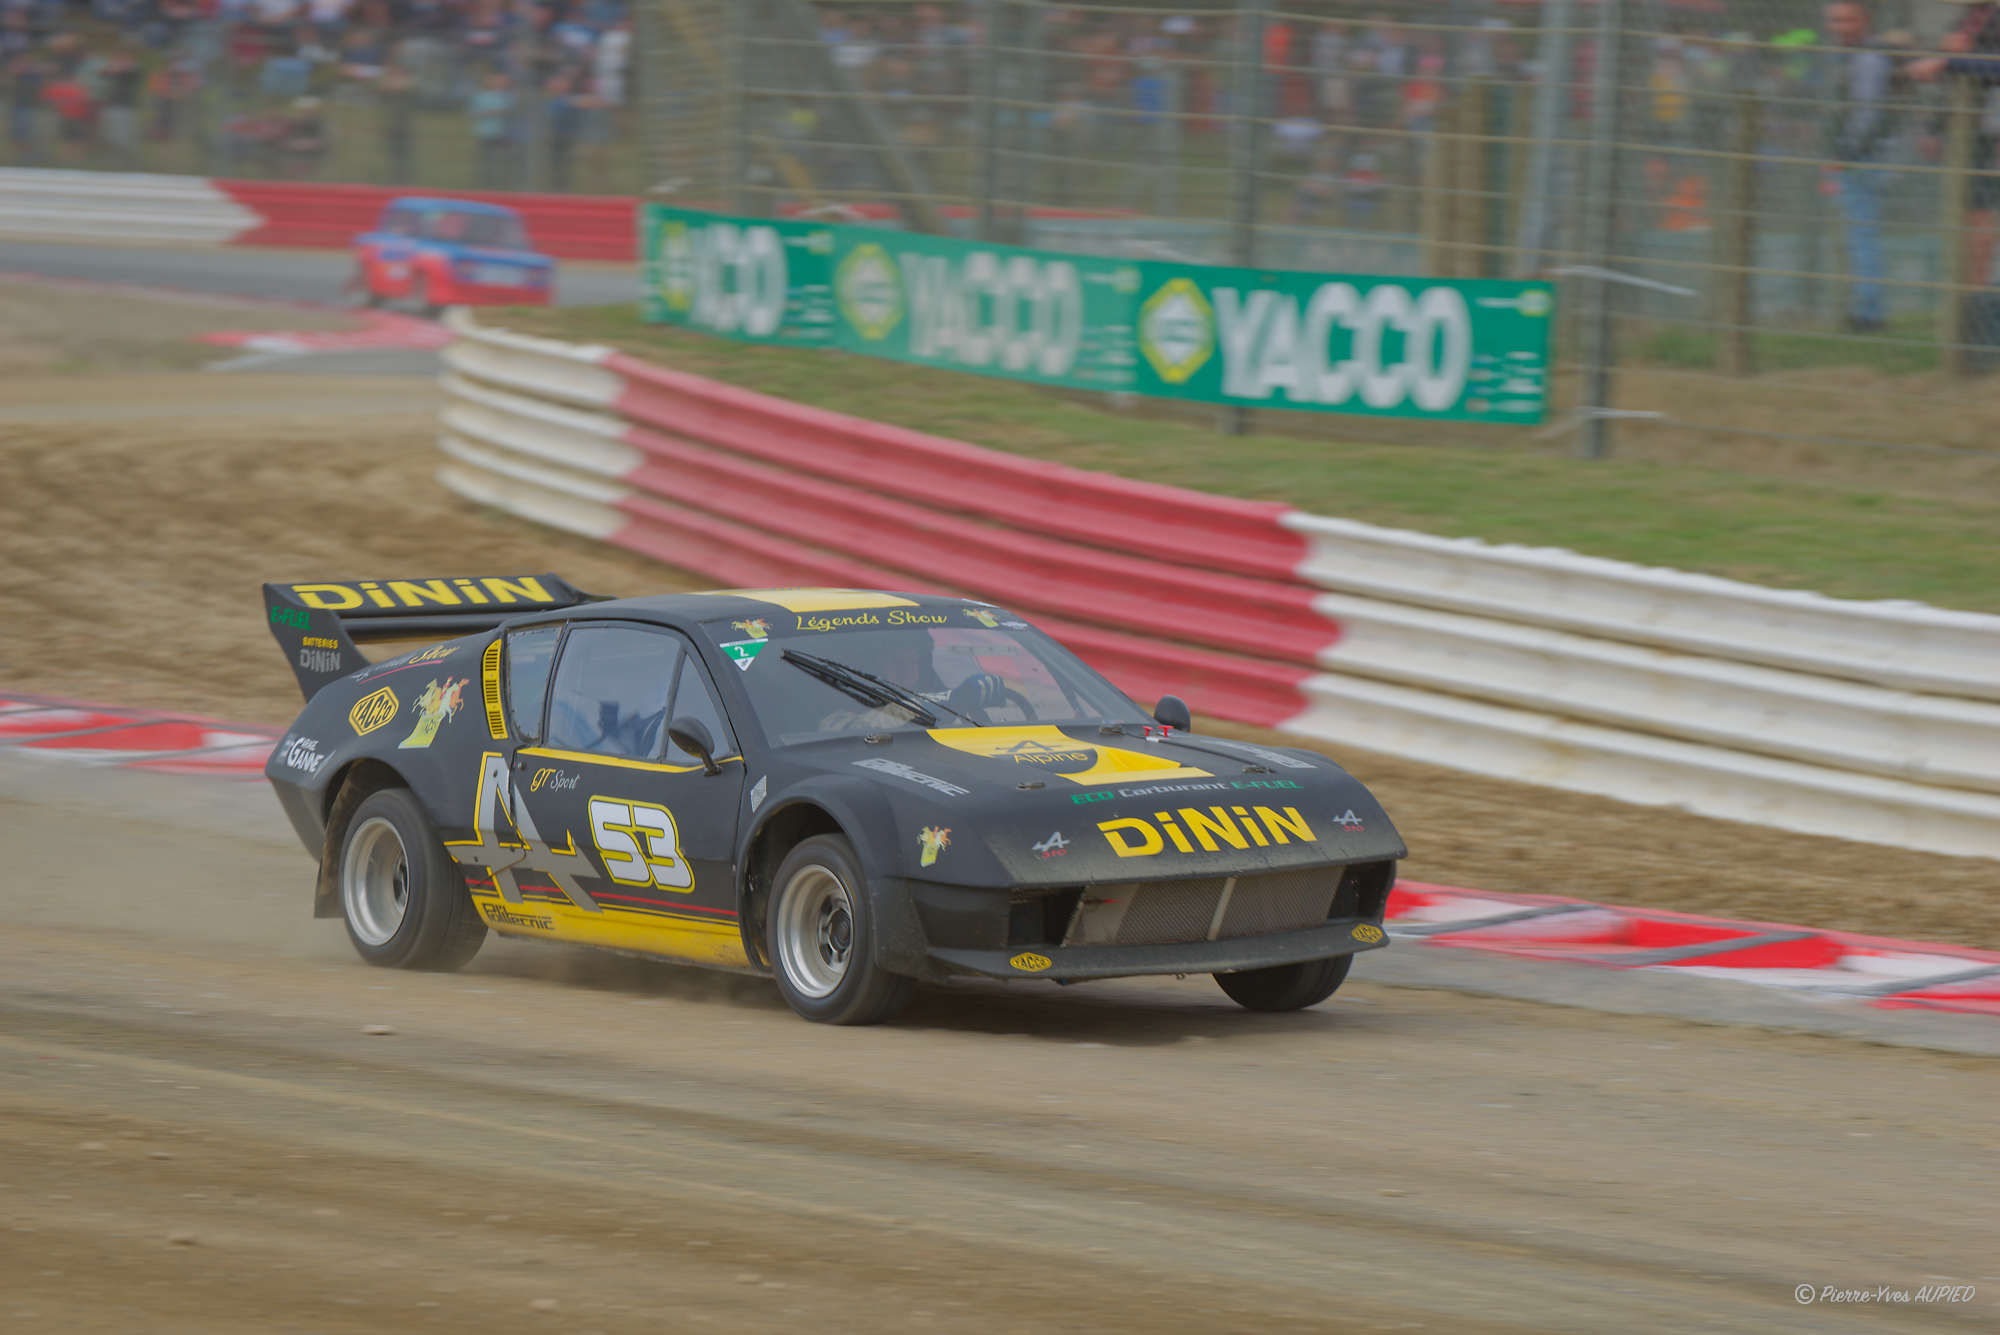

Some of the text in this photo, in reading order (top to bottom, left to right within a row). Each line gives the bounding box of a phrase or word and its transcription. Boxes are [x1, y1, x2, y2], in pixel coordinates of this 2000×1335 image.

[1211, 282, 1472, 412] YACCO
[887, 610, 948, 625] Show
[302, 636, 339, 649] BATTERIES
[353, 694, 392, 729] YACCO
[1014, 752, 1089, 766] Alpine
[550, 770, 580, 792] Sport
[1071, 780, 1304, 805] ECO Carburant E-FUEL
[588, 795, 696, 894] 53
